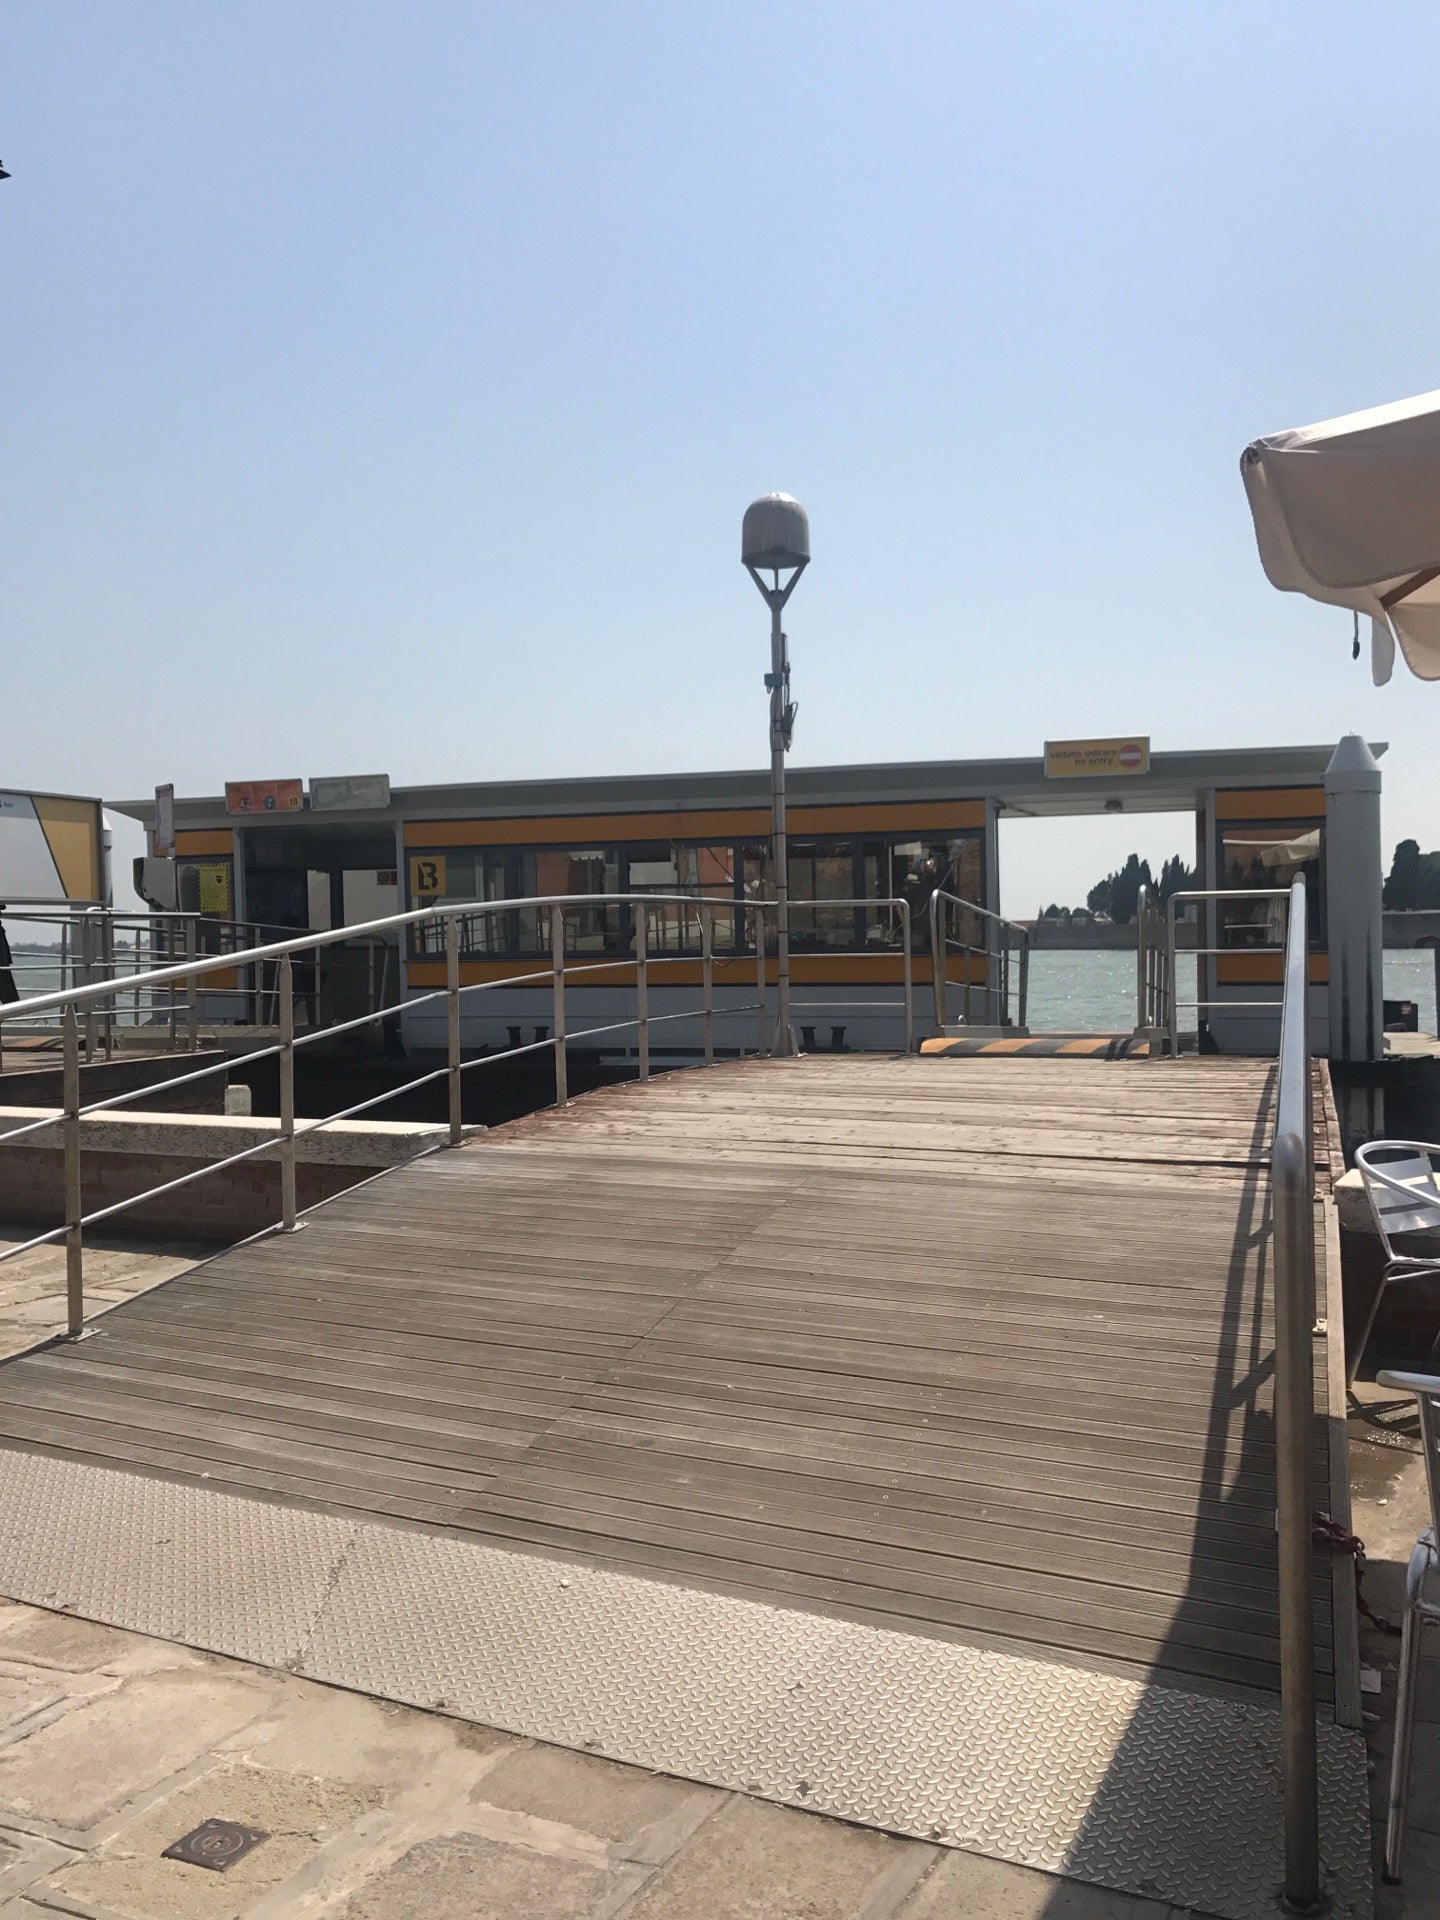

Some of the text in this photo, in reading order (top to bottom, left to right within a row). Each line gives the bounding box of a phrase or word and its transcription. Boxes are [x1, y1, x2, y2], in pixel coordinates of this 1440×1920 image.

[1074, 757, 1113, 766] no entry
[418, 862, 438, 890] B
